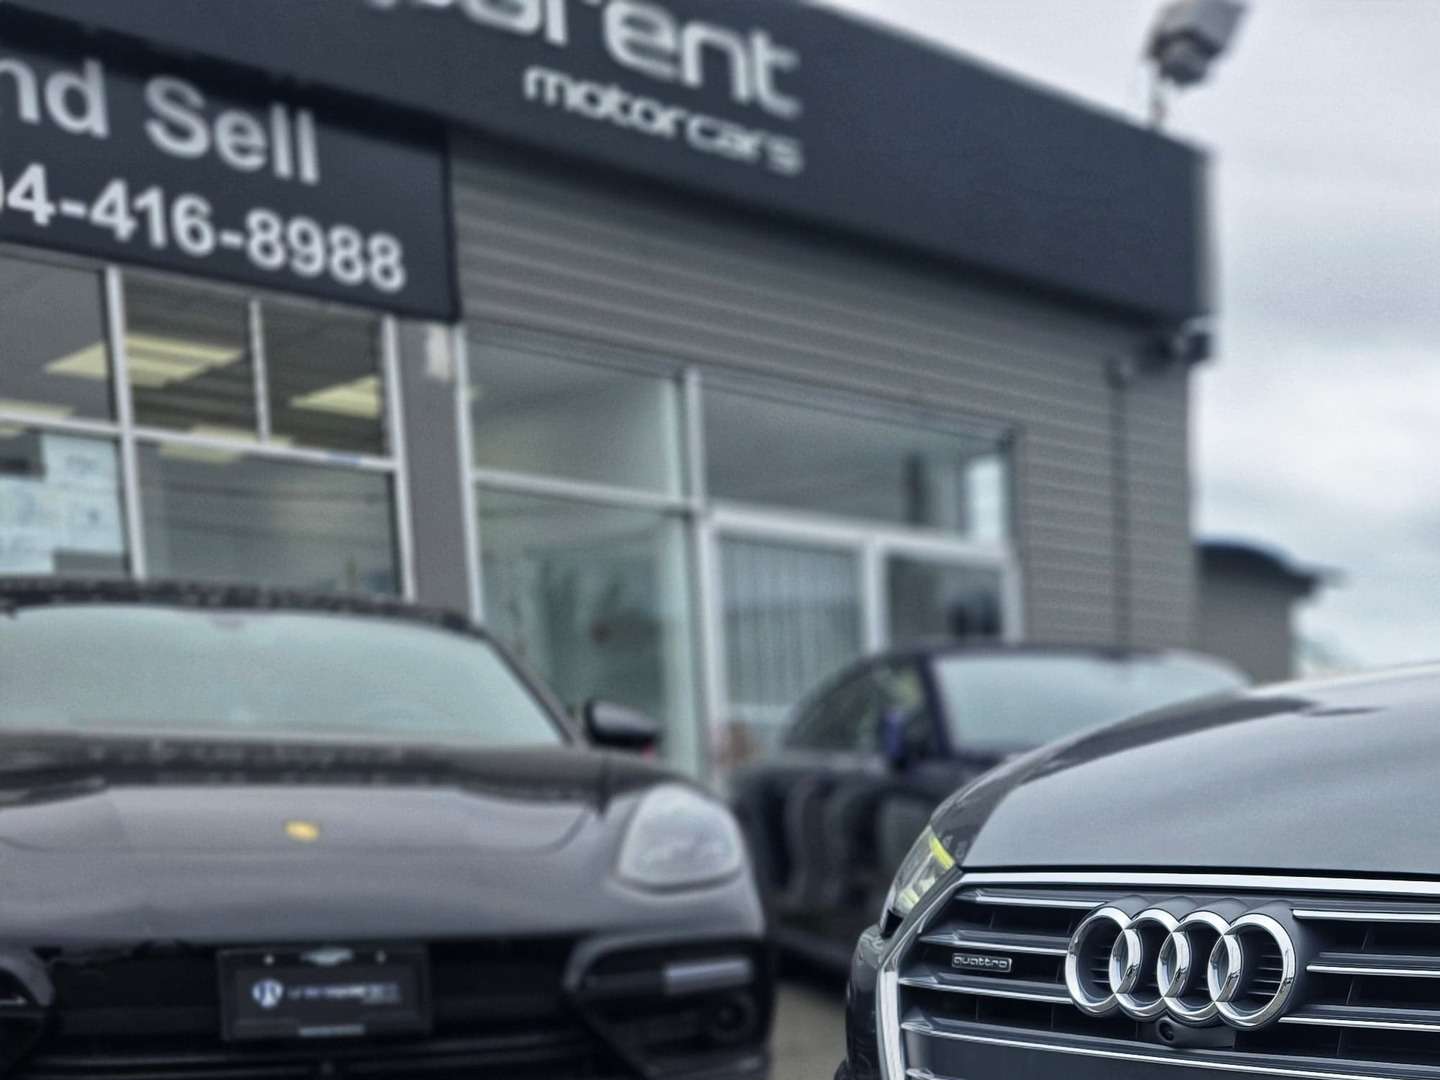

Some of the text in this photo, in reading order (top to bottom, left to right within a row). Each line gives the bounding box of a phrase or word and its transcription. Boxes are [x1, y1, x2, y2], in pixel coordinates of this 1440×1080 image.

[371, 0, 799, 118] rent
[144, 75, 319, 184] Sell
[522, 66, 803, 177] motorcars
[0, 163, 407, 293] 4-416-8988
[953, 956, 1008, 969] quattro
